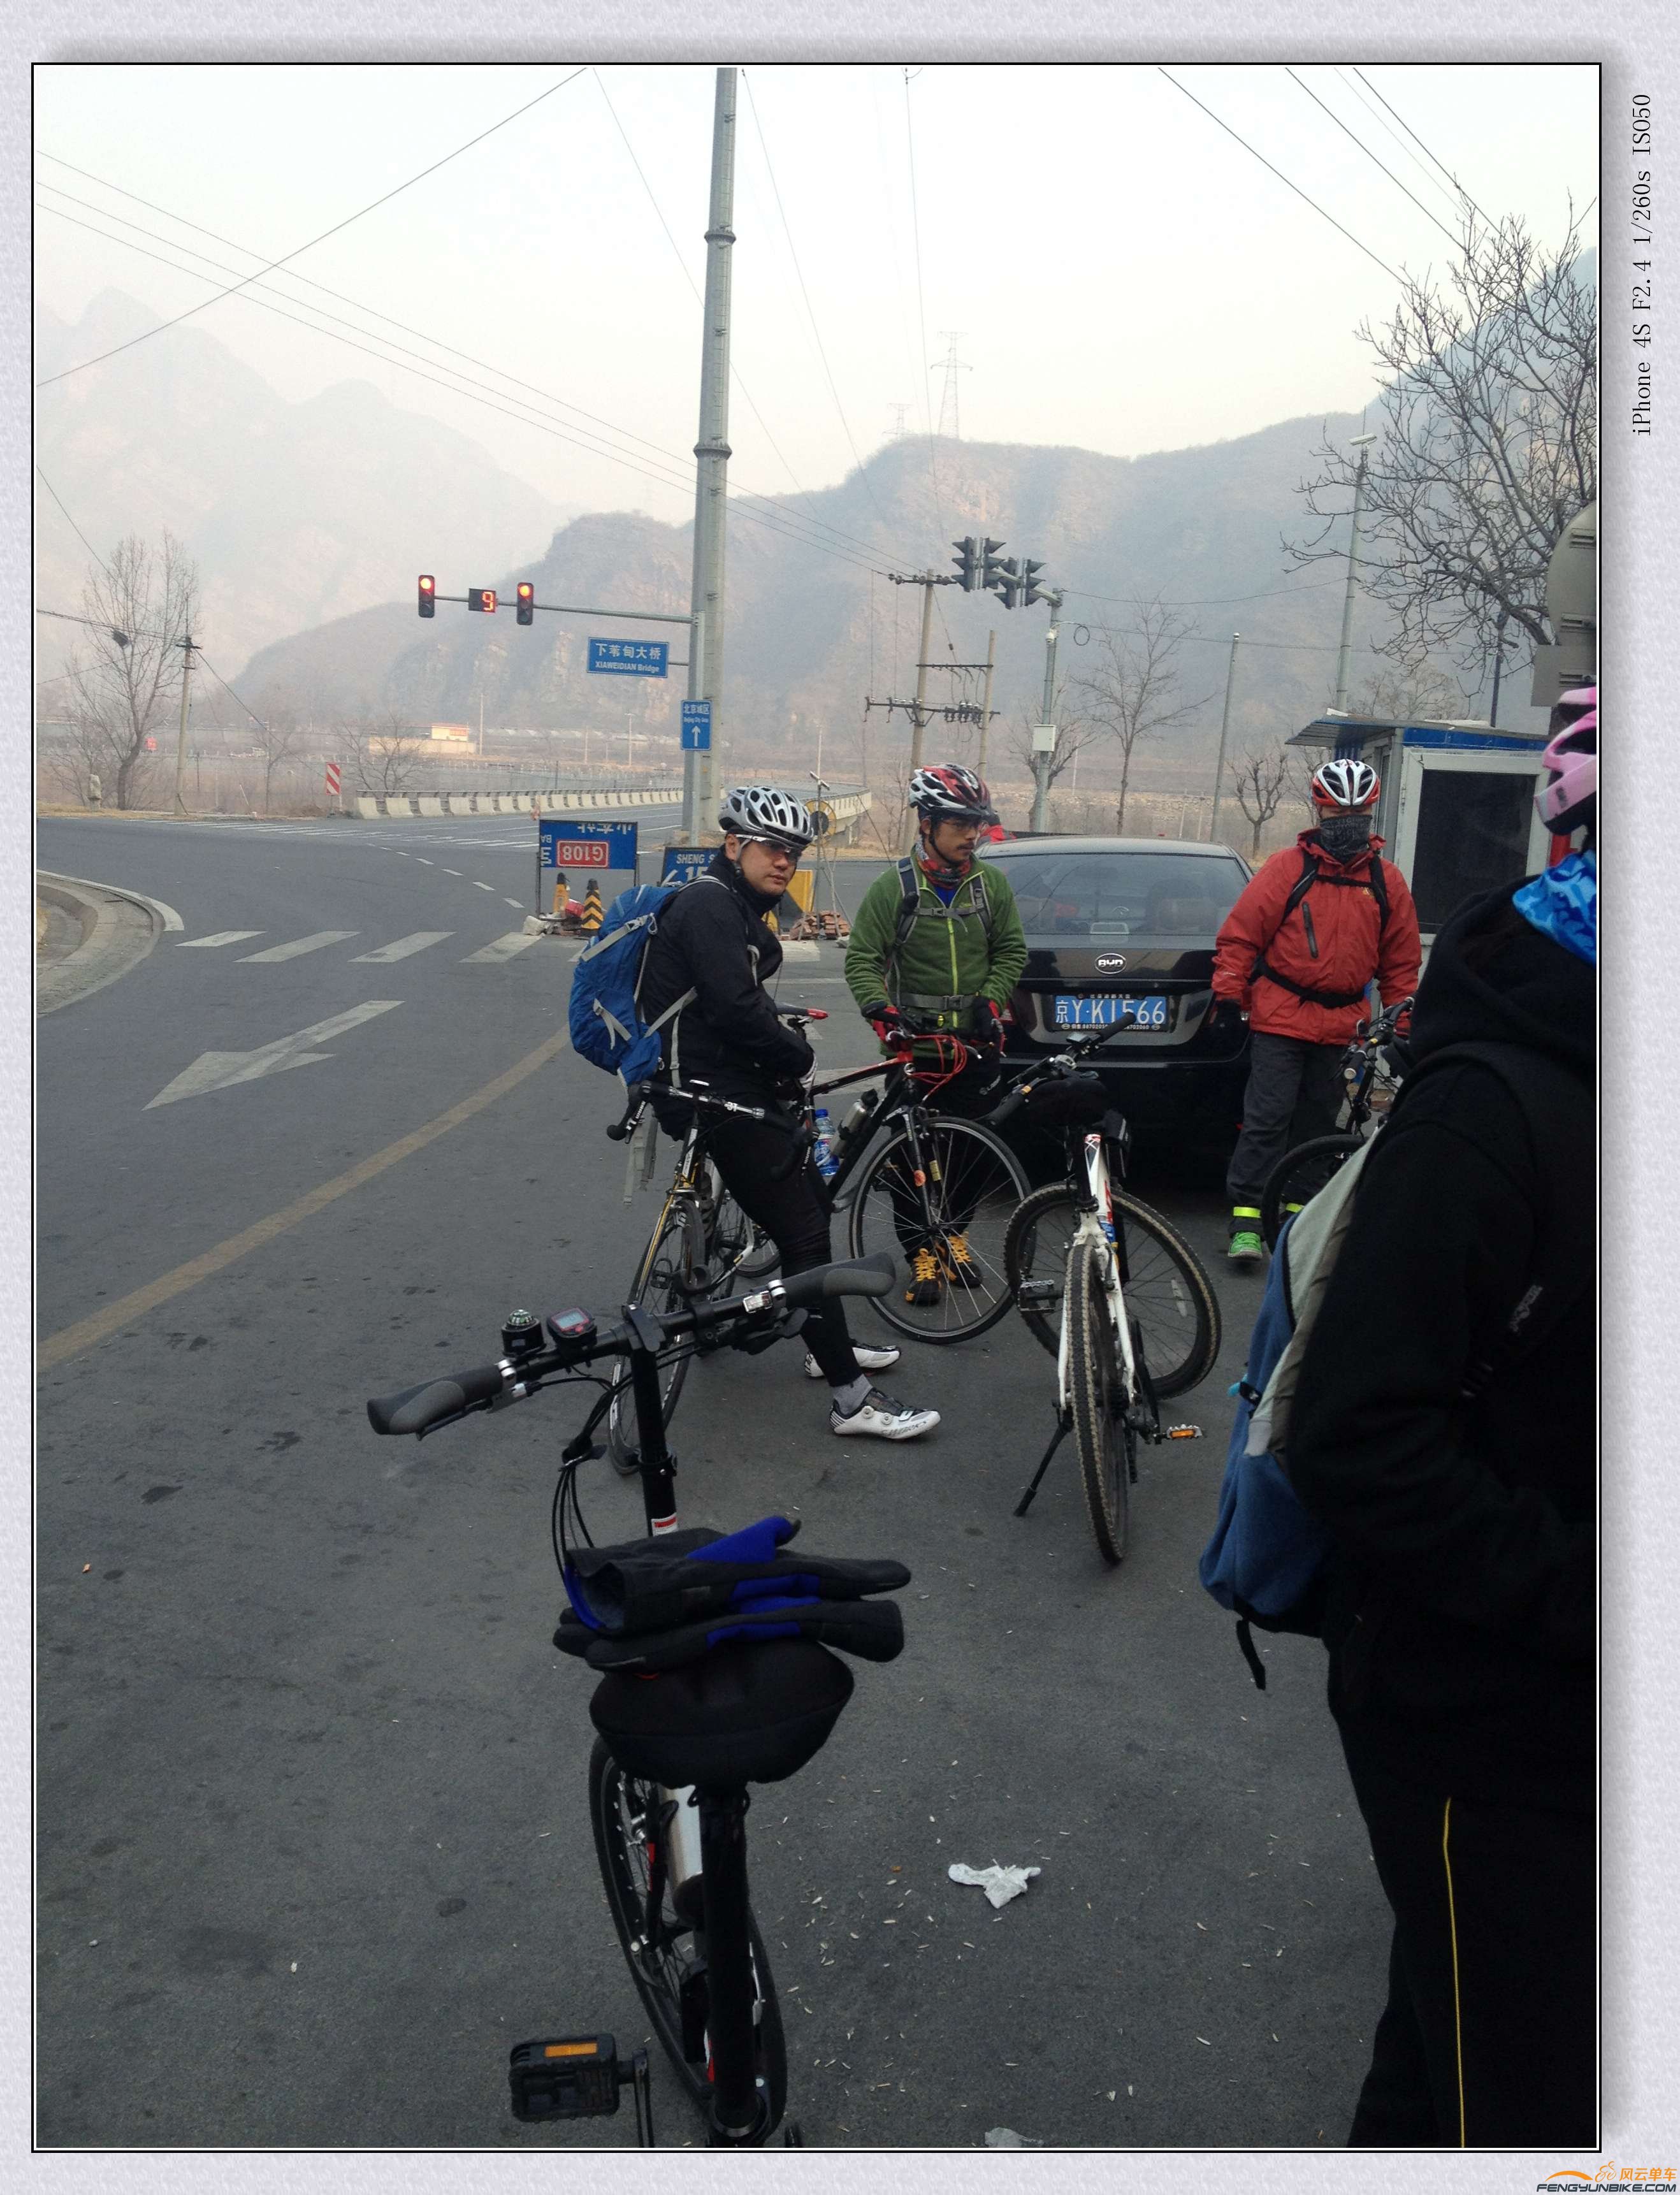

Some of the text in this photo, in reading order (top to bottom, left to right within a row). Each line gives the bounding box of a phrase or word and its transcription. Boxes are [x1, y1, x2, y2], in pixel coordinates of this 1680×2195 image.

[482, 591, 494, 611] 9
[595, 643, 661, 660] 下苇甸大桥
[637, 663, 660, 674] Bridge
[562, 846, 604, 862] G108
[676, 854, 705, 864] SHENG
